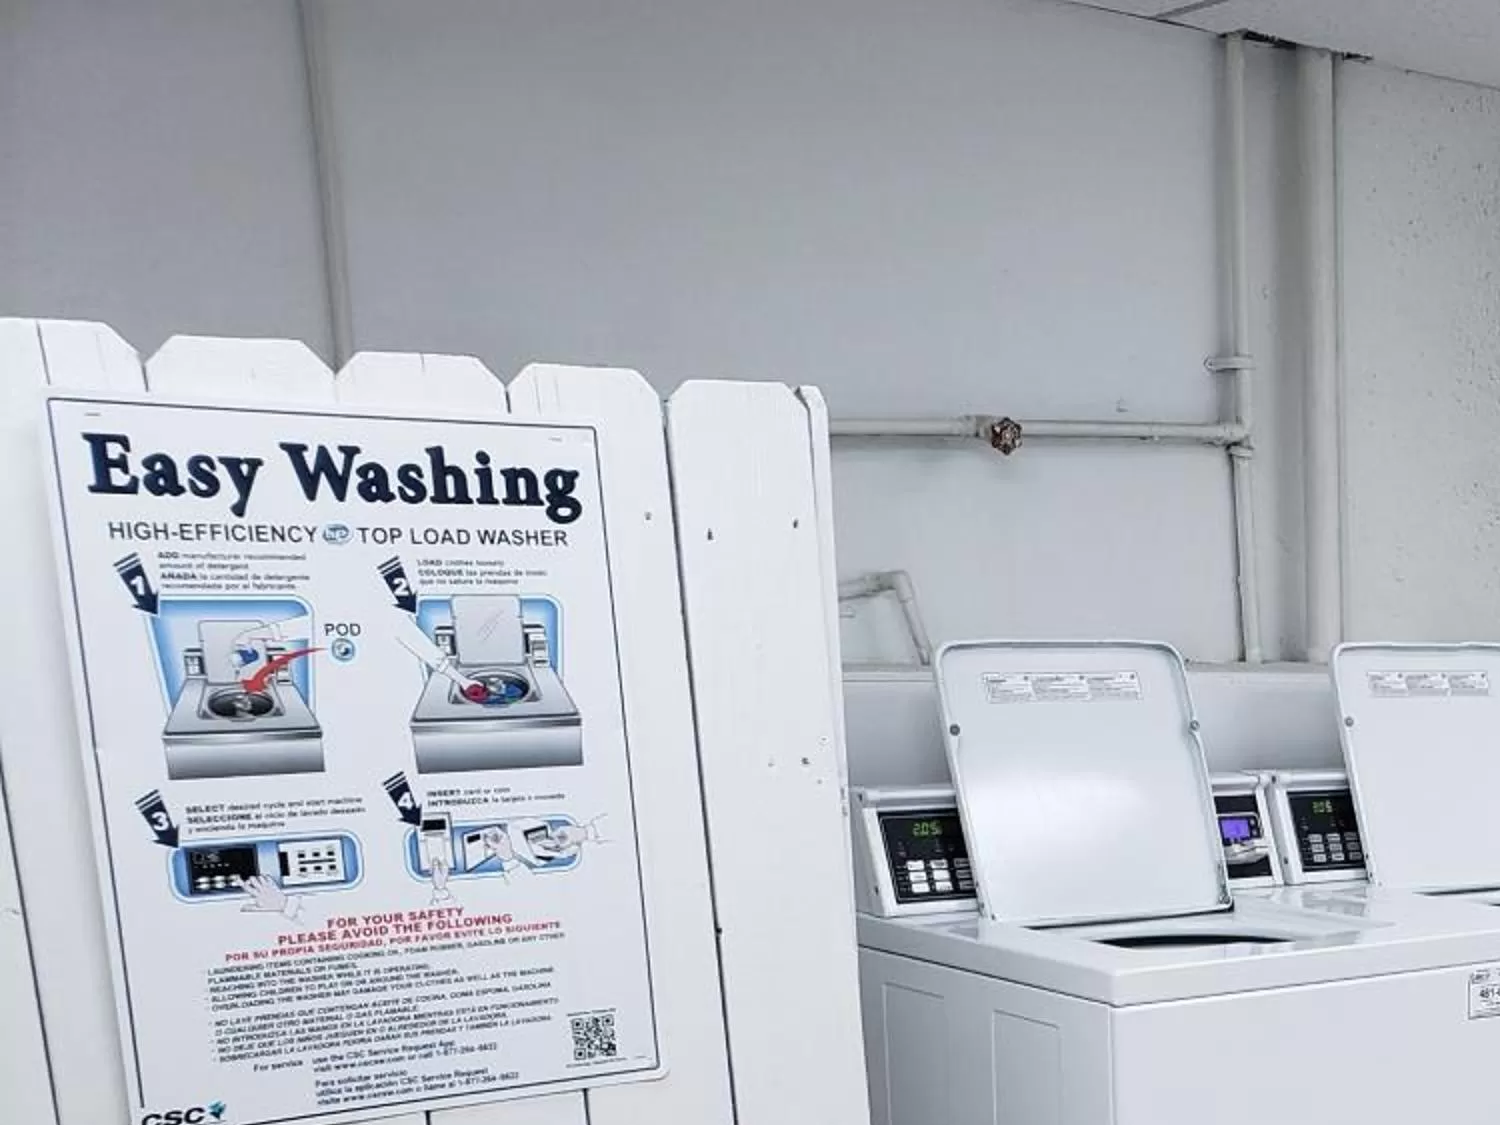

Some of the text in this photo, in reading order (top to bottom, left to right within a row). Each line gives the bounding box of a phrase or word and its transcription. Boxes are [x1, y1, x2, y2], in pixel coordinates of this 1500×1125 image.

[82, 432, 583, 525] Easy Washing
[108, 521, 318, 543] HIGH-EFFICIENCY
[356, 527, 402, 545] TOP
[410, 528, 471, 545] LOAD
[476, 529, 570, 547] WASHER
[130, 576, 146, 595] 1
[391, 577, 410, 596] 2
[324, 622, 362, 638] POD
[151, 811, 169, 832] 3
[327, 906, 465, 929] FOR YOUR SAFETY
[278, 913, 513, 946] PLEASE AVOID THE FOLLOWING
[225, 952, 249, 962] POR
[253, 950, 268, 959] SU
[272, 946, 314, 957] PROPIA
[389, 936, 412, 946] POR
[415, 932, 451, 943] FAVOR
[489, 927, 503, 936] LO
